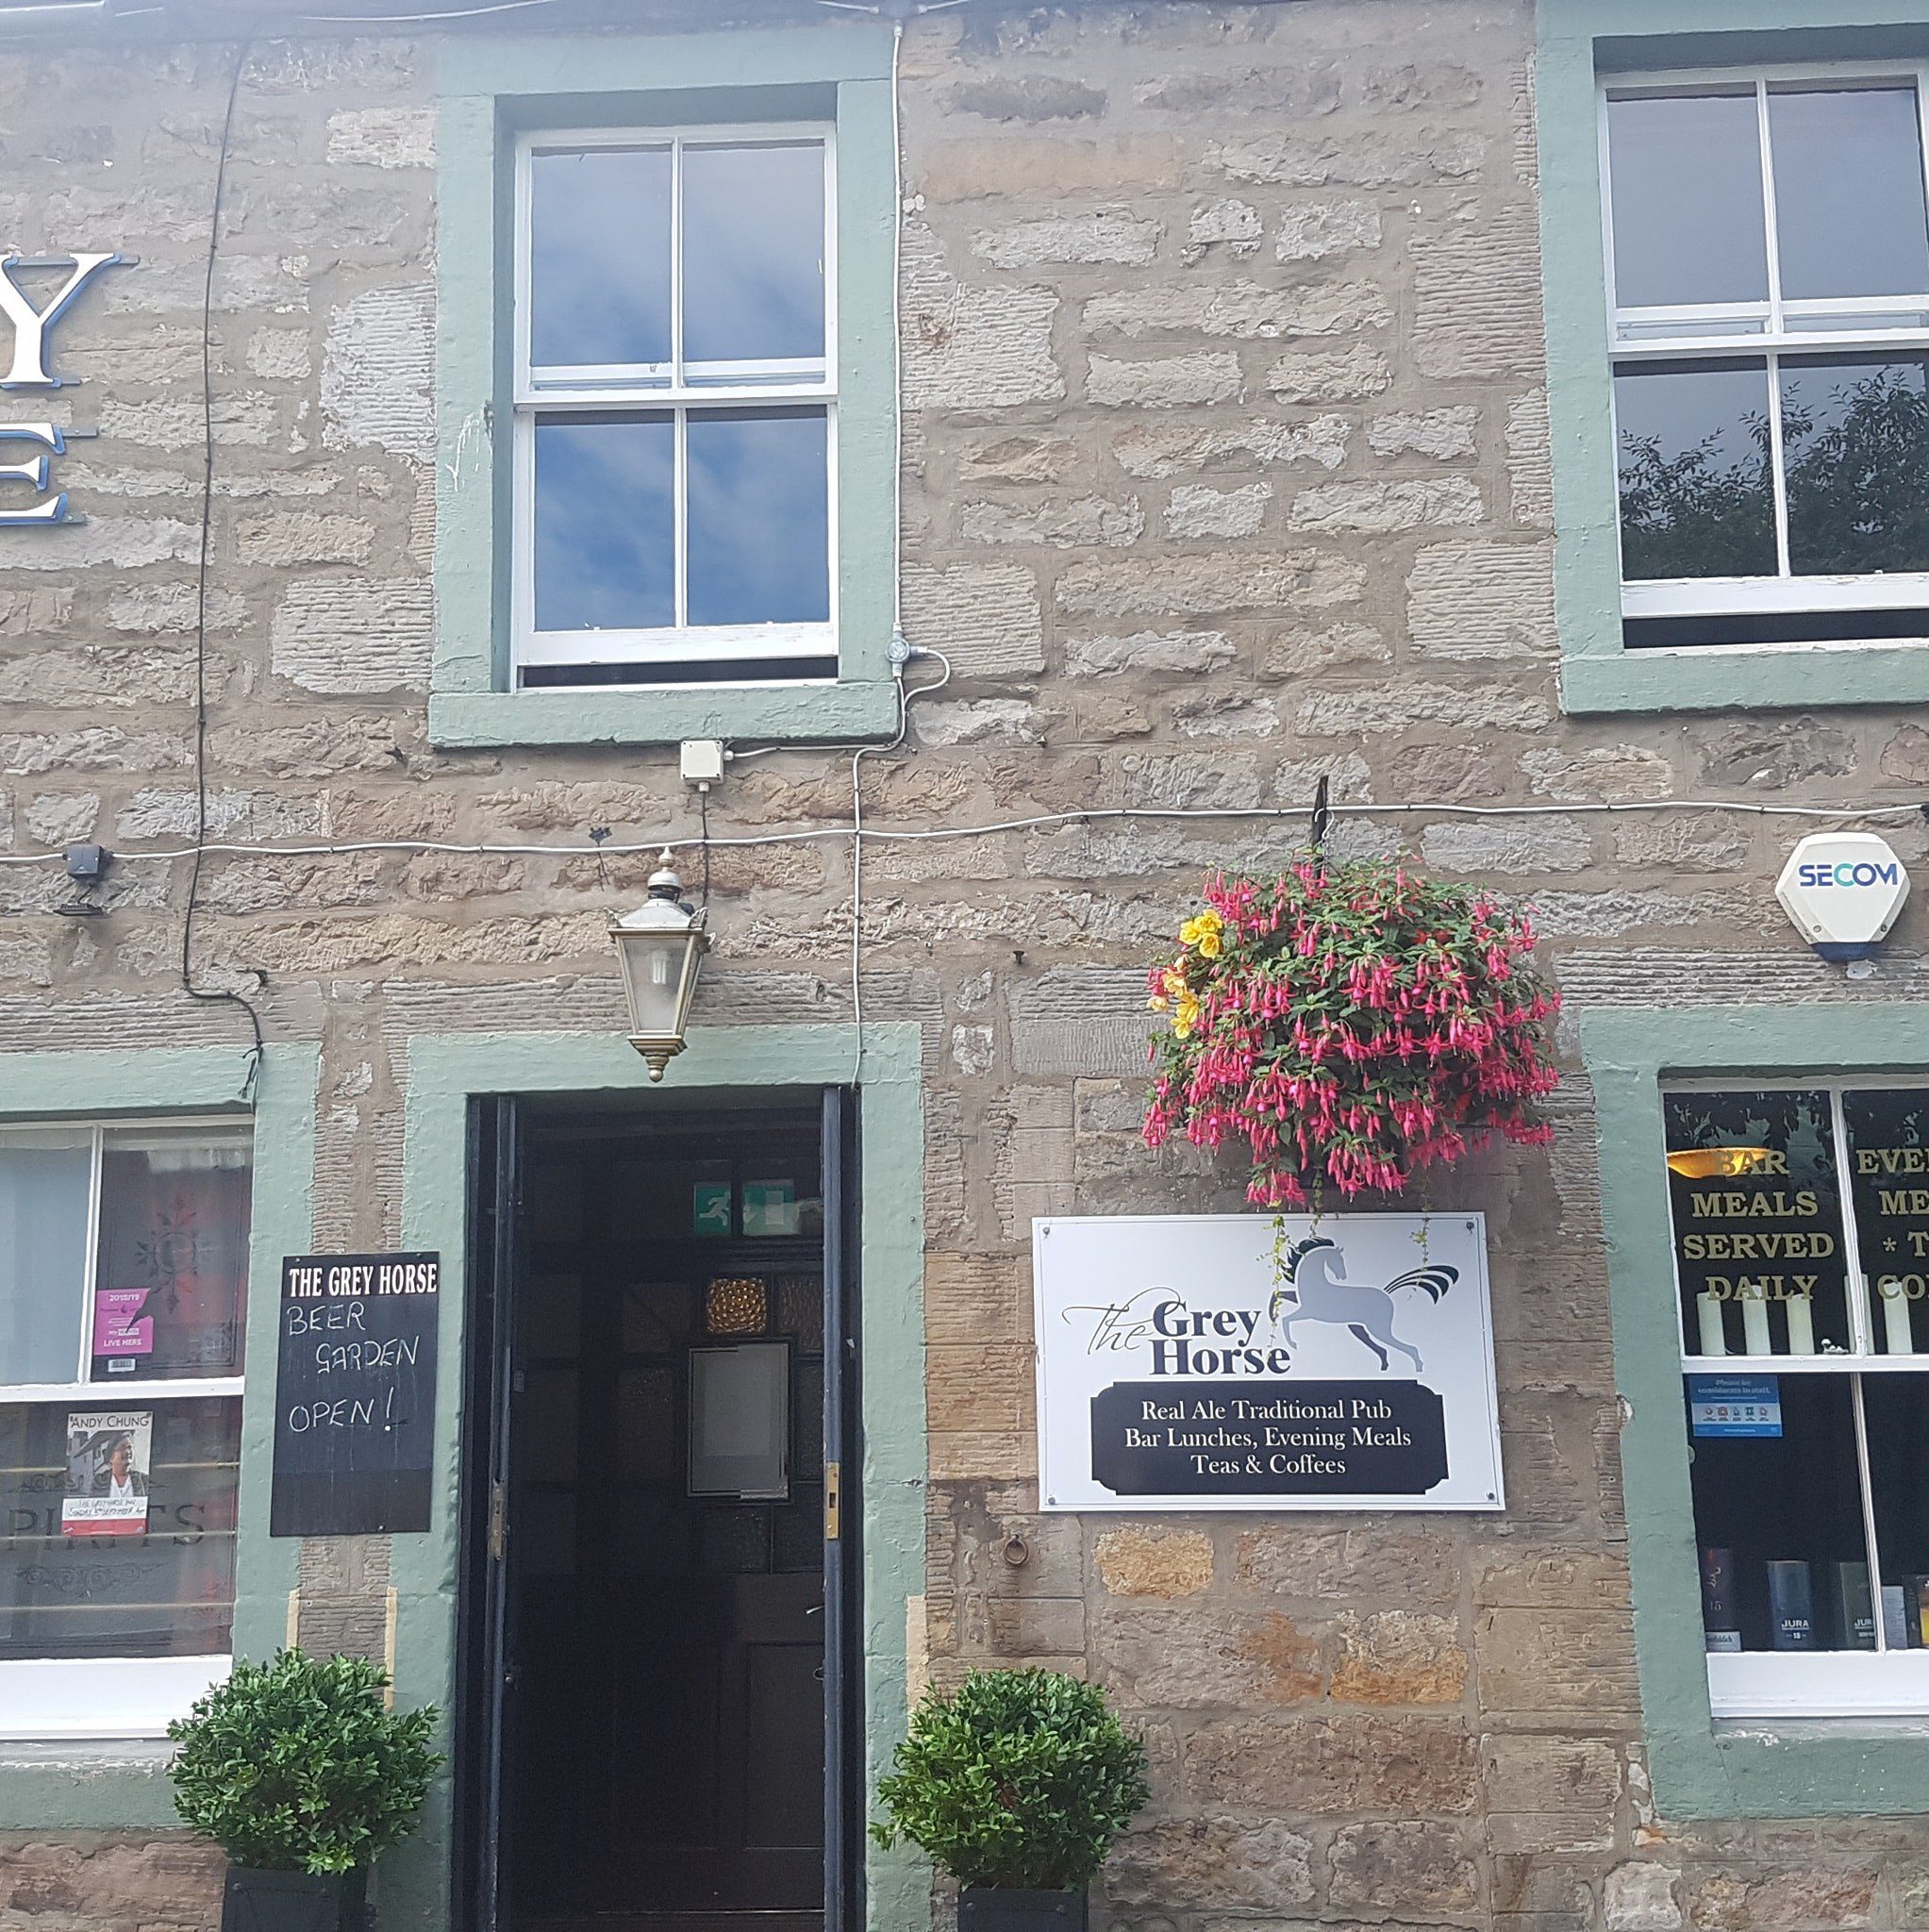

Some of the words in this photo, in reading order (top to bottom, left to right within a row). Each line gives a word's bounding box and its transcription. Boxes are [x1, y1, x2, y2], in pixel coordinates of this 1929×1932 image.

[1799, 863, 1898, 887] SECOM
[1716, 1150, 1789, 1174] BAR
[1855, 1148, 1929, 1174] EVE
[1690, 1191, 1818, 1218] MEALS
[1683, 1233, 1835, 1259] SERVED
[289, 1268, 323, 1297] THE
[328, 1266, 374, 1296] GREY
[379, 1264, 438, 1294] HORSE
[1705, 1275, 1818, 1301] DAILY
[1877, 1274, 1929, 1300] CO
[287, 1301, 366, 1336] BEER
[1061, 1287, 1179, 1356] The
[1153, 1300, 1262, 1348] Grey
[316, 1336, 420, 1374] GARDEN
[1148, 1339, 1291, 1375] Horse
[71, 1417, 103, 1428] ANDY
[107, 1415, 149, 1427] CHUNG
[1141, 1401, 1185, 1420] Real
[1191, 1400, 1226, 1420] Ale
[1232, 1399, 1344, 1419] Traditional
[1351, 1399, 1391, 1419] Pub
[1125, 1427, 1161, 1447] Bar
[1167, 1427, 1258, 1449] Lunches,
[1264, 1427, 1345, 1450] Evening
[1351, 1426, 1411, 1446] Meals
[1190, 1454, 1240, 1474] Teas
[1246, 1454, 1263, 1474] &
[1270, 1453, 1347, 1474] Coffees
[1781, 1620, 1810, 1628] JURA
